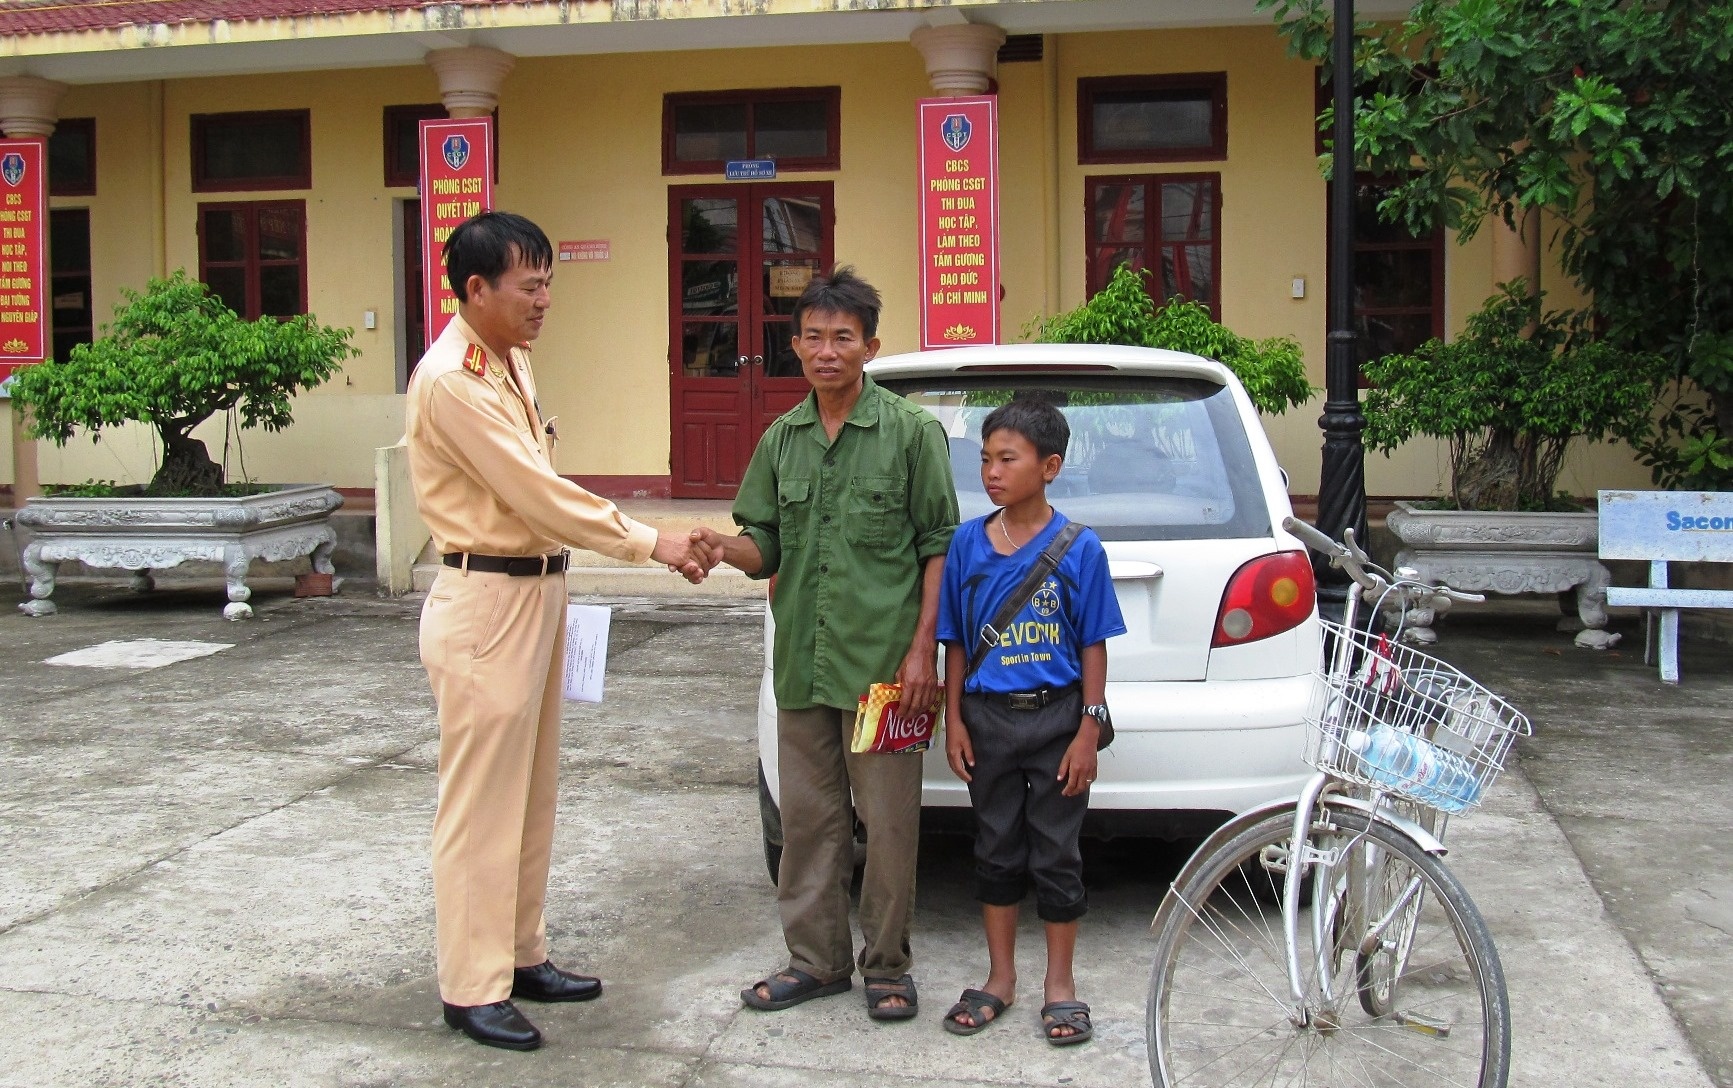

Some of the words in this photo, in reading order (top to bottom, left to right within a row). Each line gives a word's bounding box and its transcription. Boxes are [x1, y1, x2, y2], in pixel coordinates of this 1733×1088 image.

[945, 159, 969, 172] CBCS
[433, 174, 460, 195] PHÒNG
[462, 177, 482, 194] CSGT
[930, 175, 961, 192] PHÒNG
[963, 177, 986, 191] CSGT
[436, 196, 461, 220] QUYẾT
[463, 198, 480, 218] TÂM
[941, 197, 955, 210] THI
[957, 196, 975, 210] ĐUA
[0, 208, 16, 221] HÒNG
[938, 216, 957, 232] HỌC
[959, 213, 978, 231] TẬP,
[937, 233, 956, 248] LÀM
[958, 234, 980, 248] THEO
[933, 250, 952, 267] TẤM
[954, 252, 985, 267] GƯƠNG
[940, 273, 958, 289] ĐẠO
[960, 268, 978, 285] ĐỨC
[440, 295, 460, 314] NĂM
[946, 288, 961, 304] CHÍ
[963, 290, 987, 304] MINH
[1001, 653, 1021, 666] Sport
[1021, 653, 1030, 663] in
[1030, 652, 1051, 662] Town
